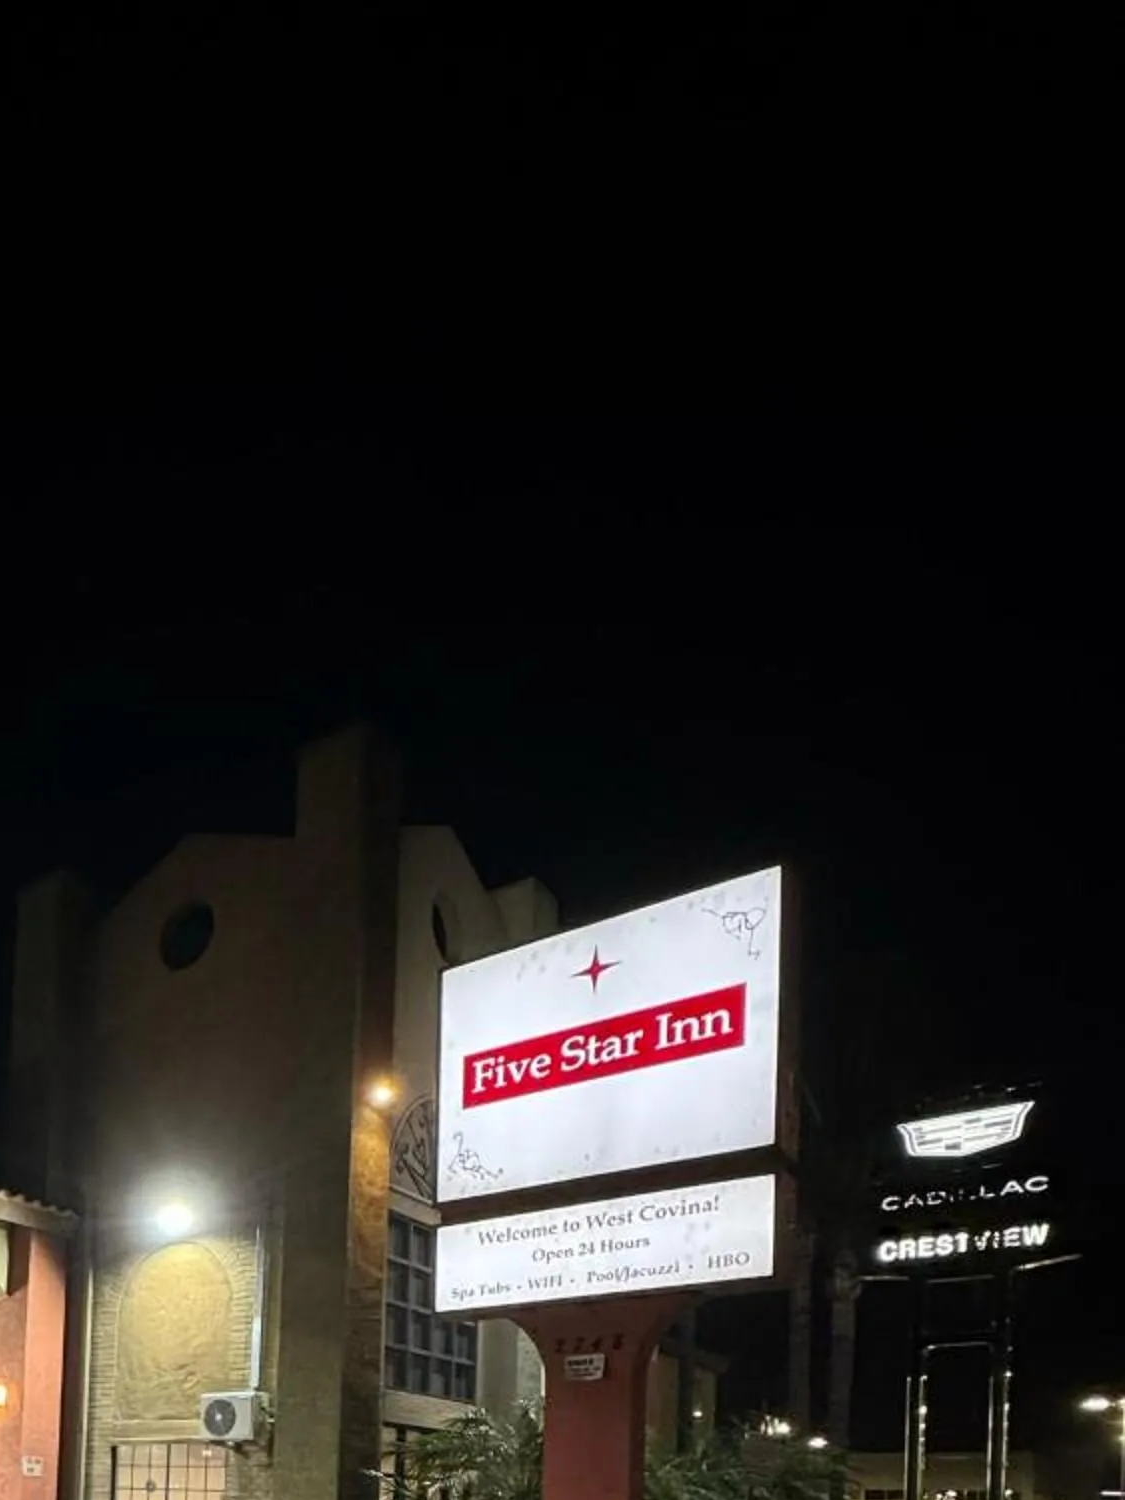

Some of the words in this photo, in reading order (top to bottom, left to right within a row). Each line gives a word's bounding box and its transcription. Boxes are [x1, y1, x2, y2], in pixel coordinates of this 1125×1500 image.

[472, 1055, 551, 1094] Five
[560, 1035, 643, 1073] Star
[655, 1007, 733, 1050] Inn
[478, 1223, 558, 1246] Welcome
[562, 1219, 580, 1233] to
[586, 1210, 633, 1230] West
[639, 1194, 720, 1221] Covina!
[451, 1286, 475, 1301] Spa
[479, 1281, 511, 1296] Tubs
[708, 1251, 751, 1269] HBO
[531, 1247, 574, 1265] Open
[578, 1241, 595, 1256] 24
[600, 1236, 650, 1252] Hours
